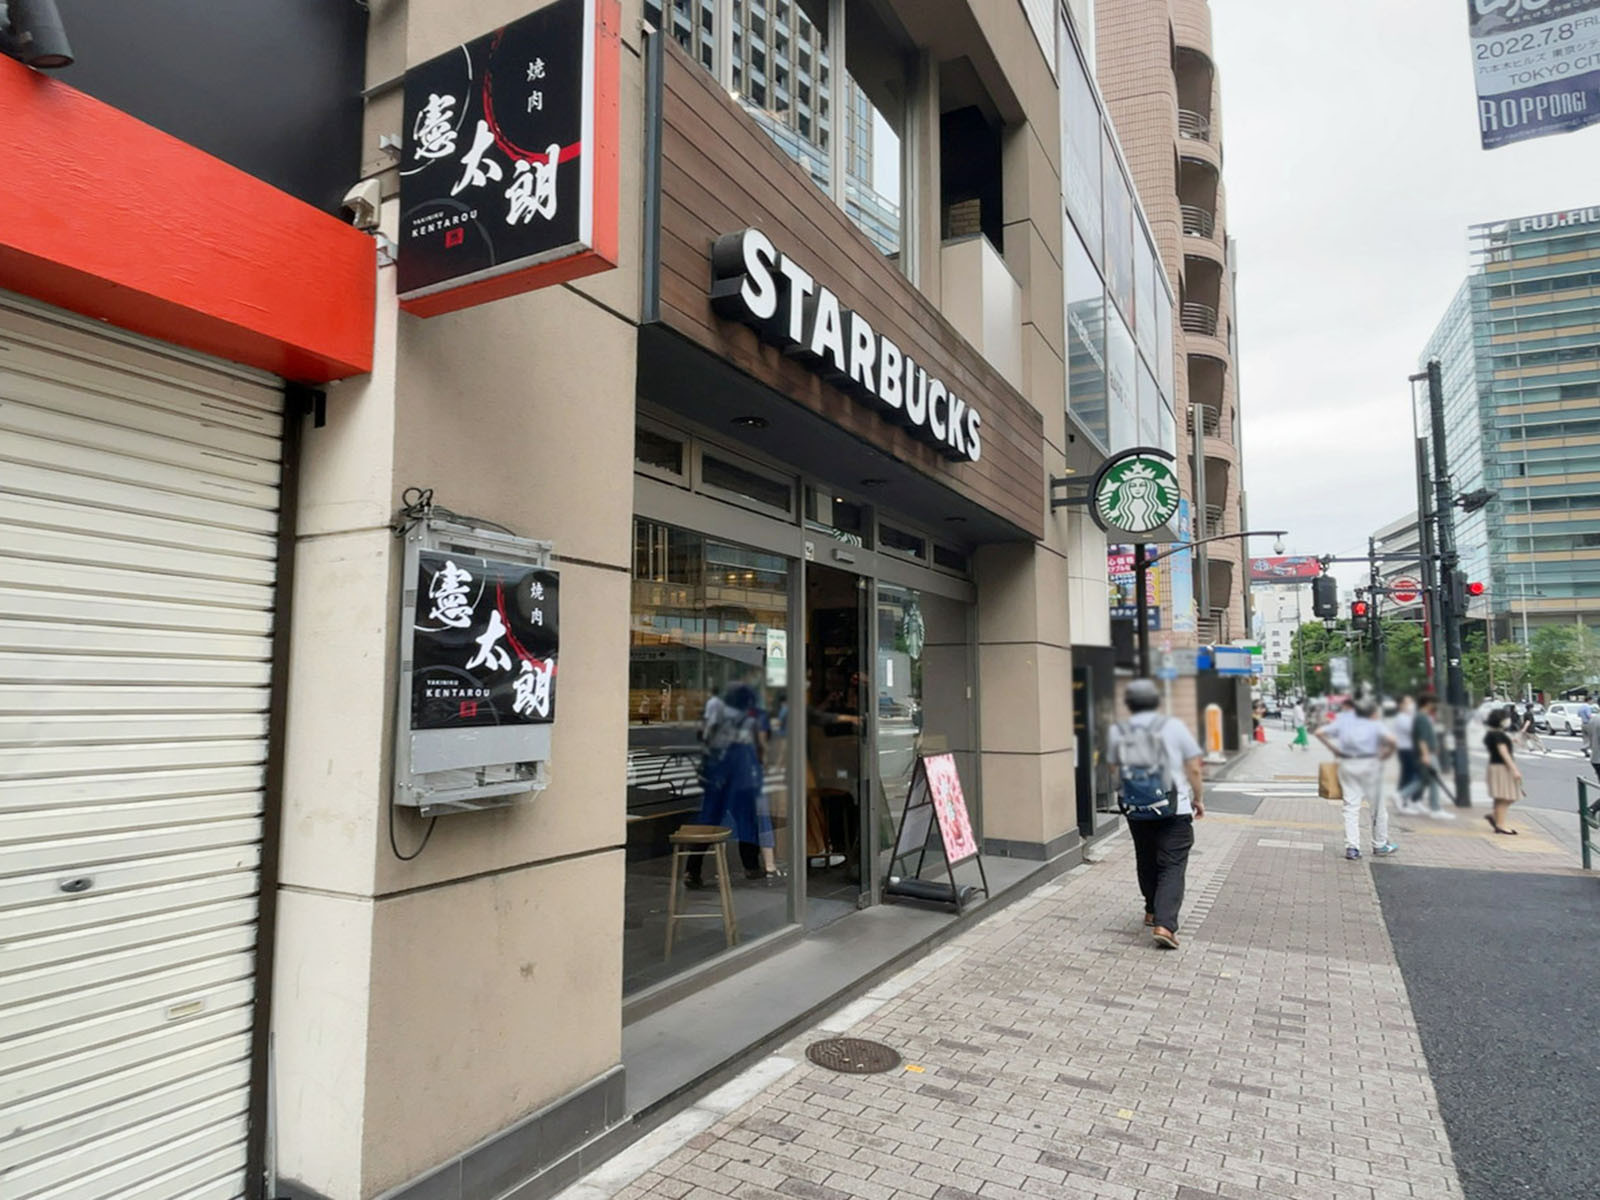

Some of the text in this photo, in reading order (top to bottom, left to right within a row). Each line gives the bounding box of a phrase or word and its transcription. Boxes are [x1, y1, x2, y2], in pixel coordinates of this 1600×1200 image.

[1476, 23, 1574, 60] 2022.7.8
[526, 57, 546, 113] 焼肉
[1508, 62, 1570, 85] TOKYO
[411, 209, 478, 237] KENTAROU
[1520, 208, 1600, 232] FUJIFIL
[741, 227, 982, 462] STARBUCKS
[530, 582, 544, 627] 焼肉
[425, 688, 491, 698] KENTAROU
